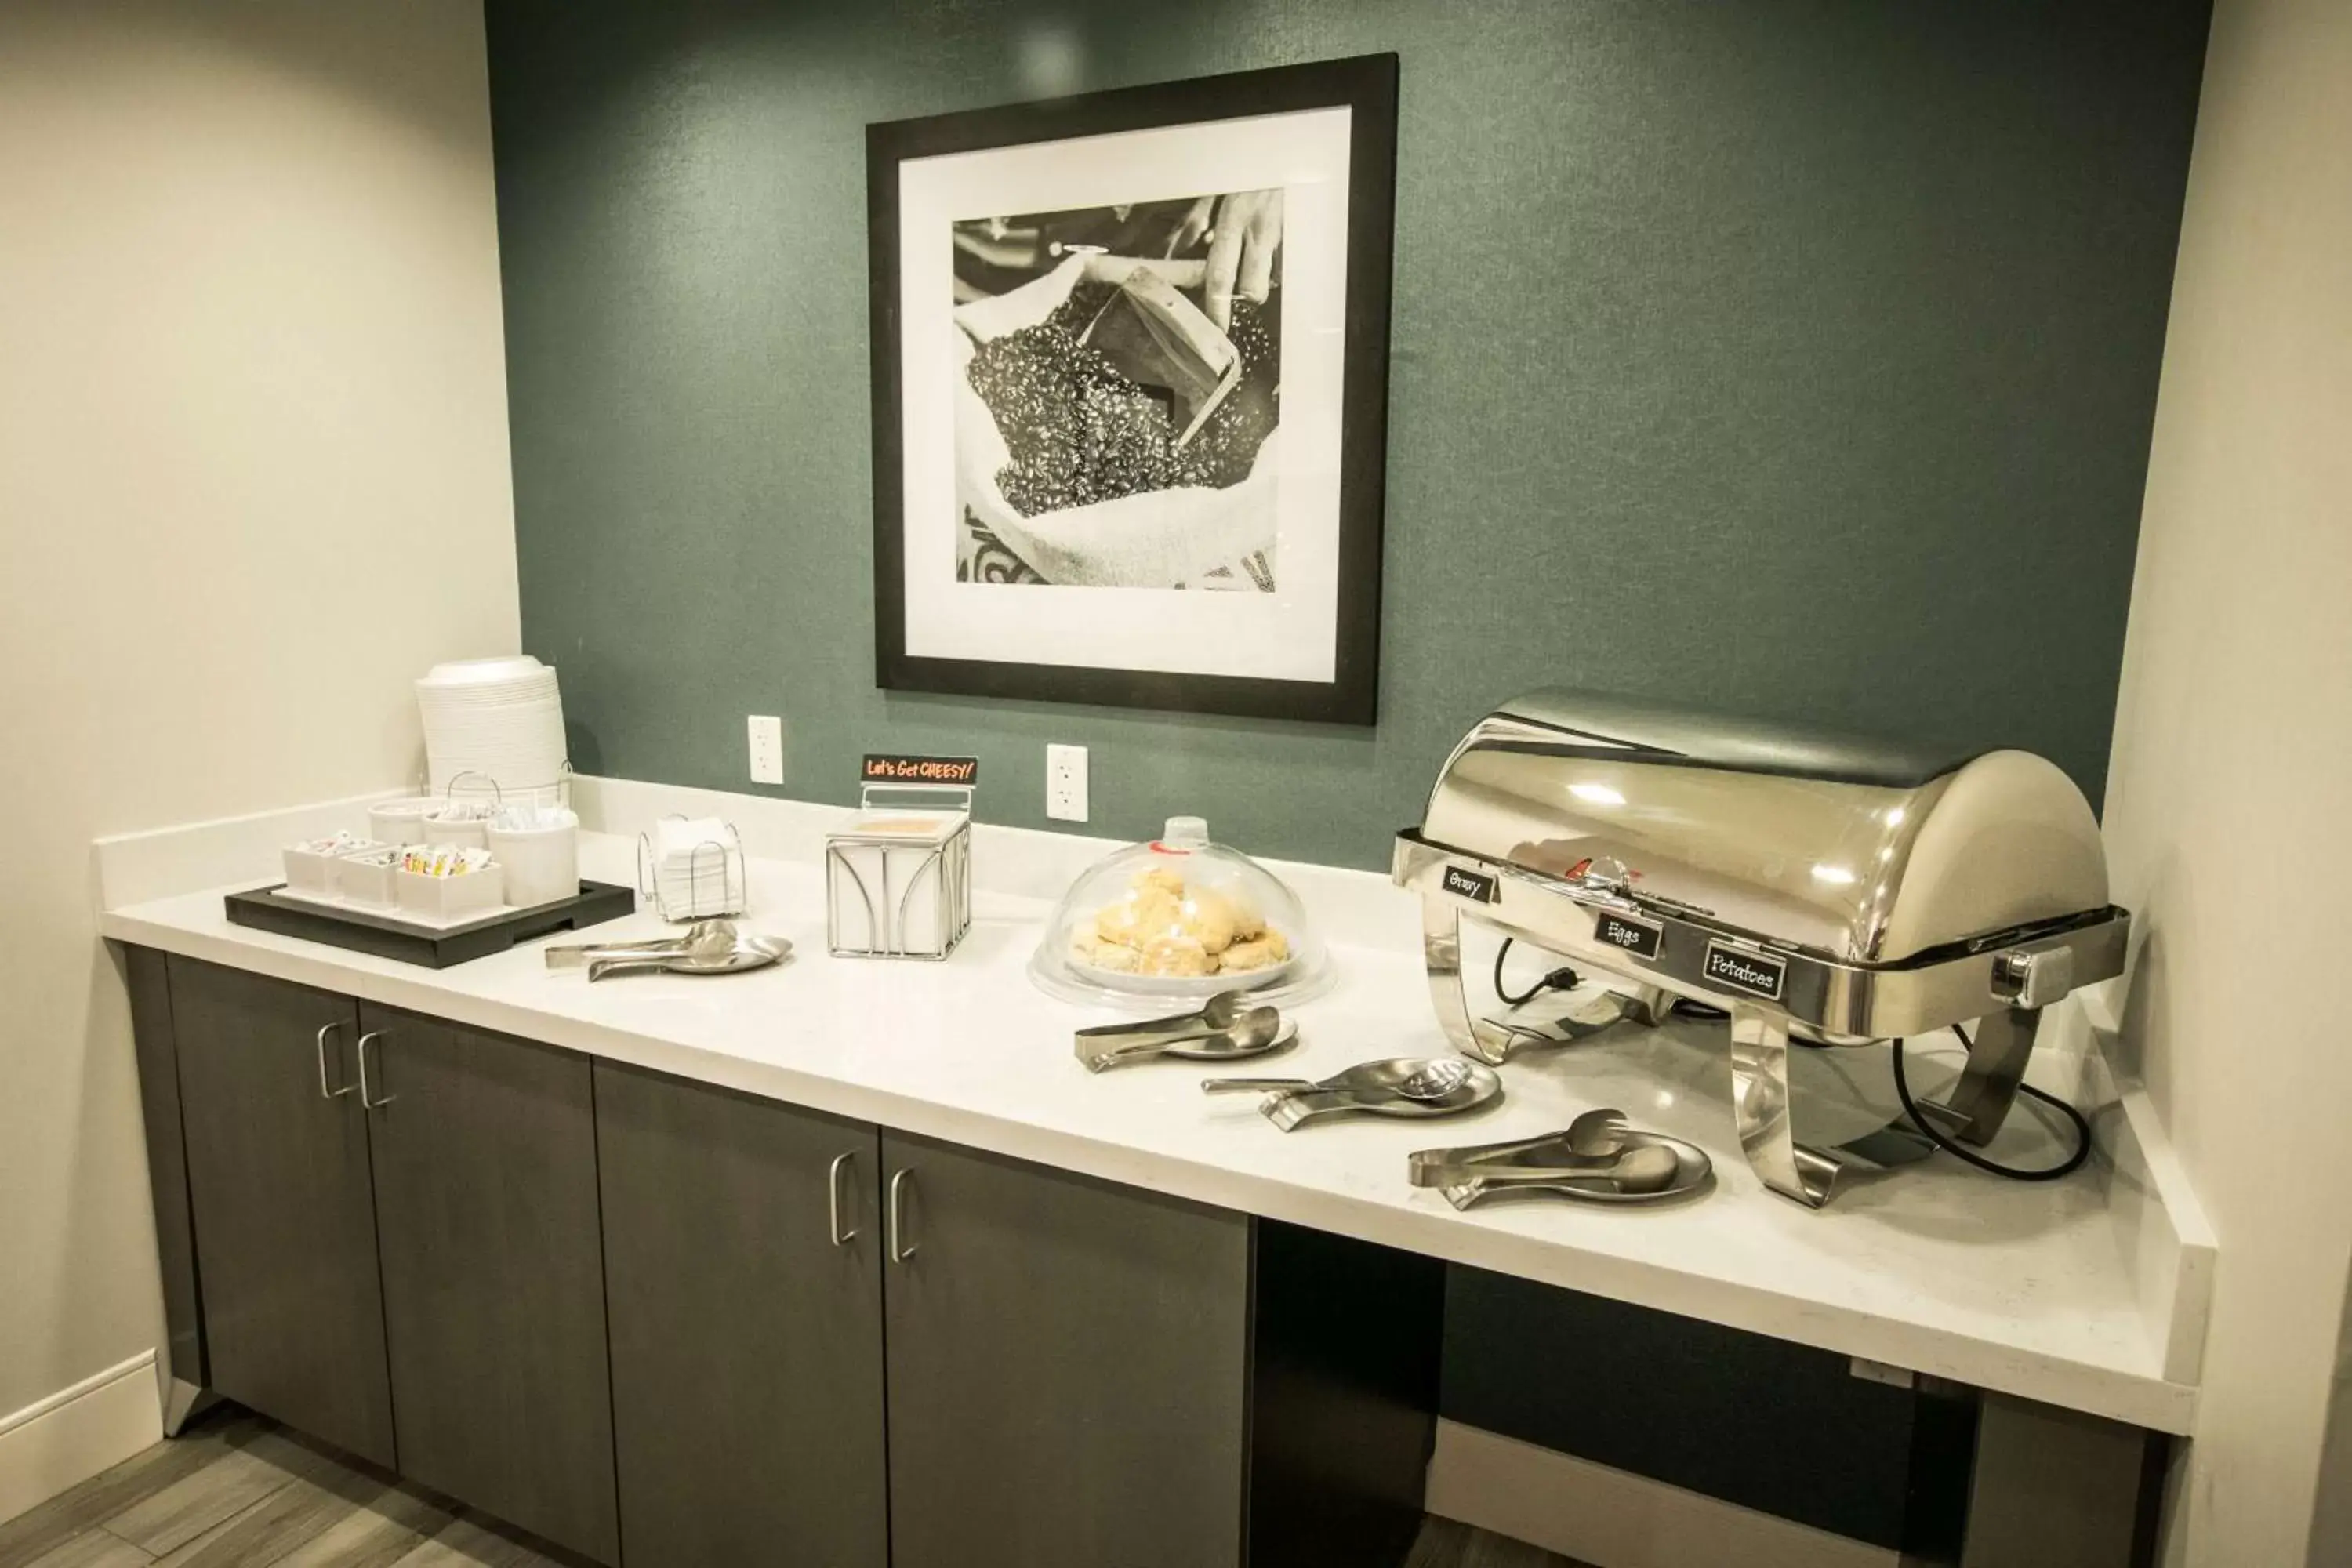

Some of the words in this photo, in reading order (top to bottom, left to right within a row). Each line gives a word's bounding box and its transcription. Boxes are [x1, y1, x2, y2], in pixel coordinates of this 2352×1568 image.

[867, 759, 895, 776] Let's
[897, 760, 919, 777] Get
[920, 761, 975, 780] CHEESY!
[1450, 872, 1481, 898] Gravy
[1607, 921, 1640, 946] Eggs
[1711, 954, 1773, 989] Potatoes
